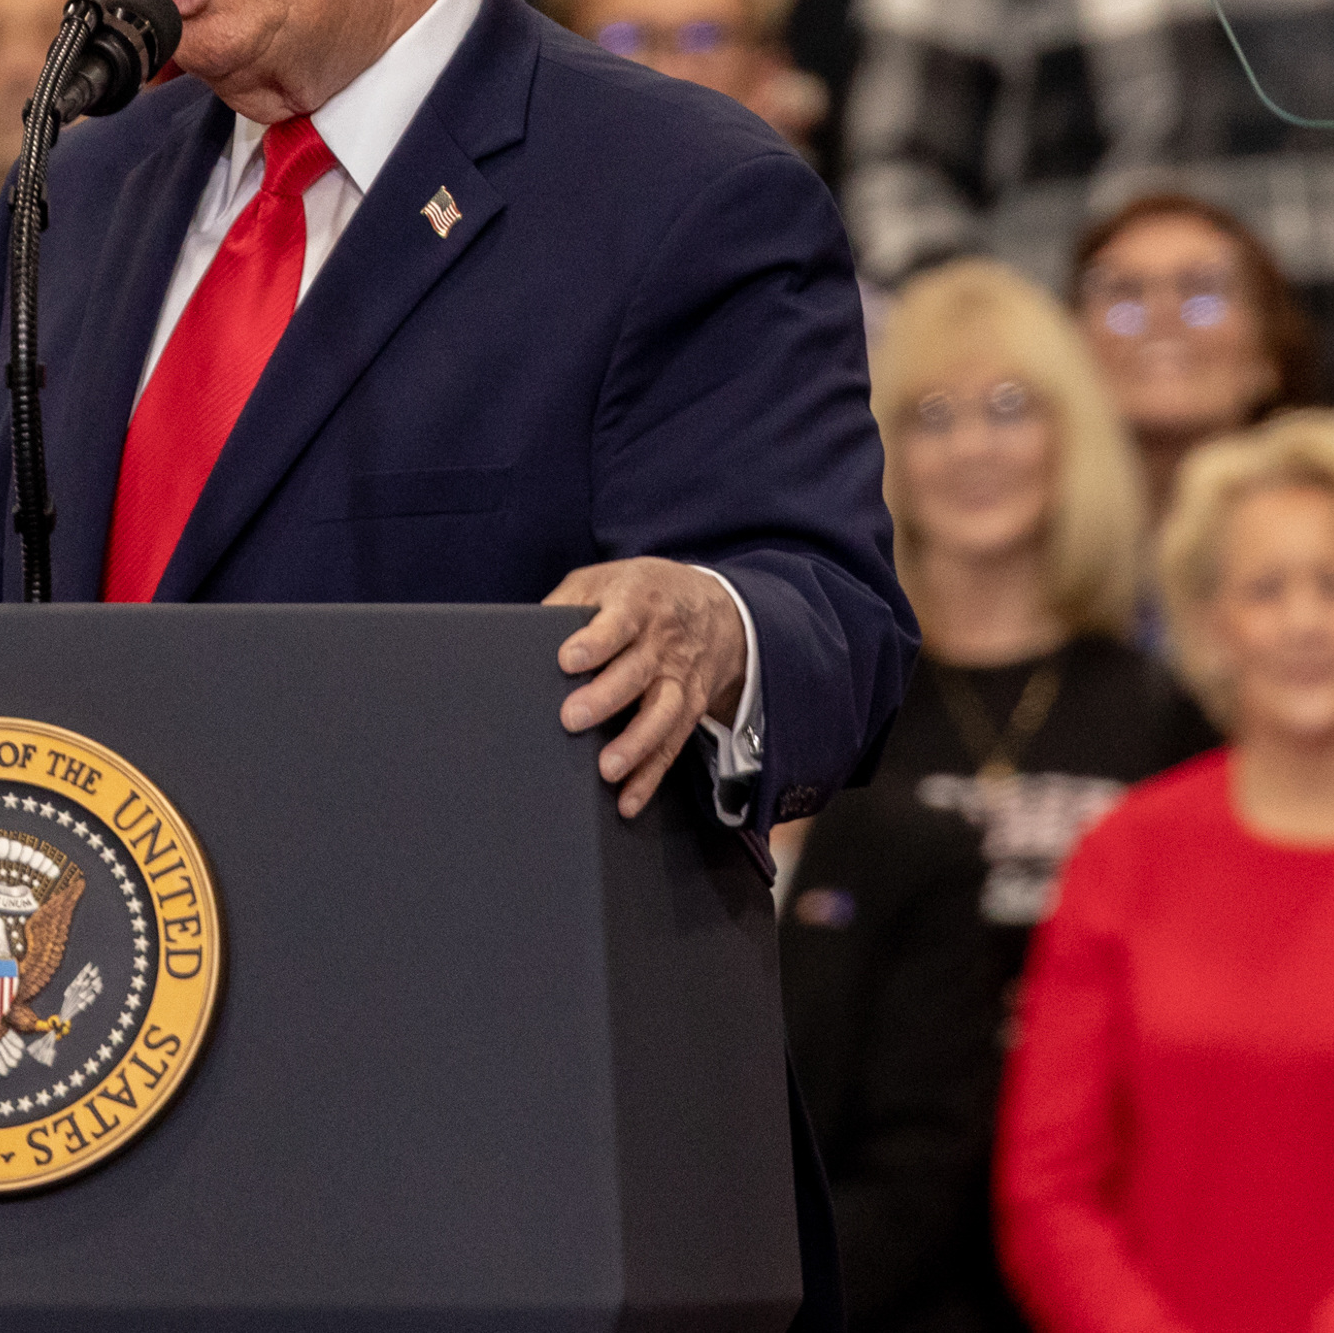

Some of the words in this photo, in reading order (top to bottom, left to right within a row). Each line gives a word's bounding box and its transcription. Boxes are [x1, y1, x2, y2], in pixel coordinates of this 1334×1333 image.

[46, 749, 103, 795] THE
[2, 898, 33, 908] UNUM
[113, 790, 204, 980] UNITED
[26, 1024, 182, 1167] STATES
